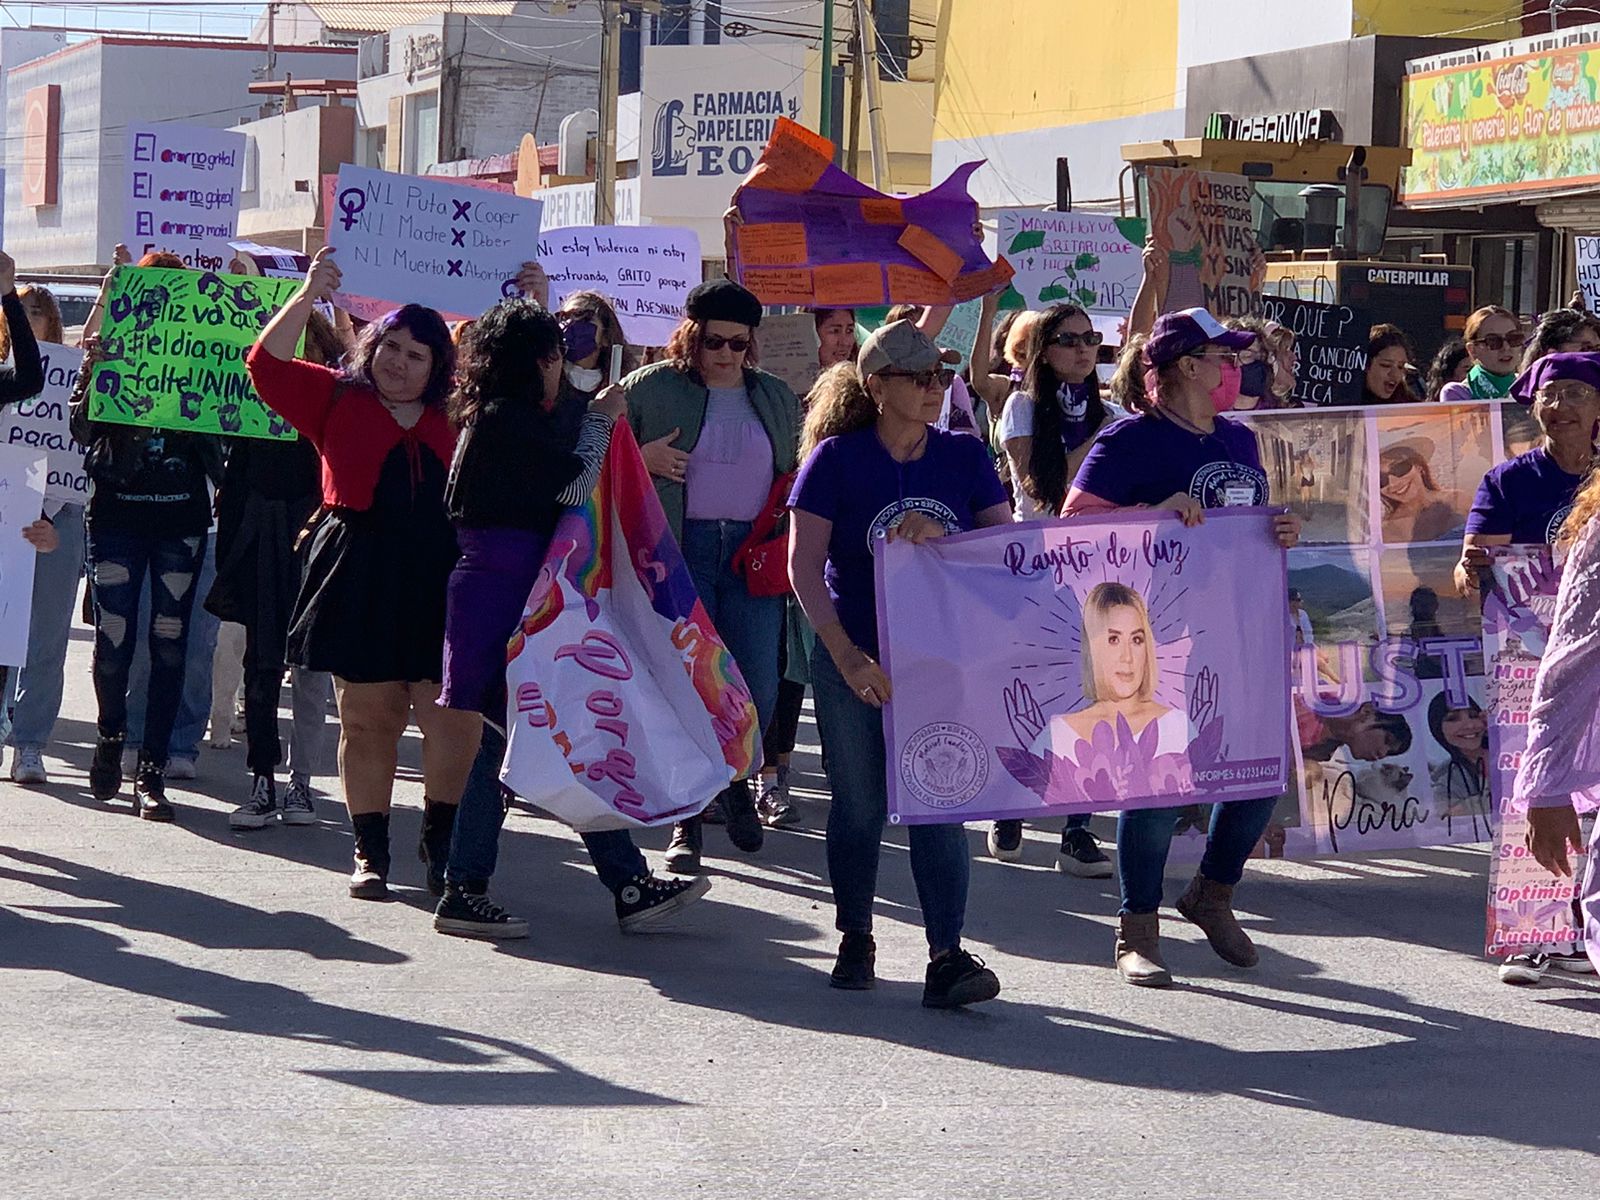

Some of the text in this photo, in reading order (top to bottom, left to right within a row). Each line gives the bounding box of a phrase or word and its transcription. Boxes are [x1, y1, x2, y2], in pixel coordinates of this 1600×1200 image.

[694, 91, 801, 119] FARMACIA y
[1548, 104, 1561, 131] de
[697, 119, 776, 142] PAPELERI
[133, 133, 156, 161] El
[133, 172, 152, 199] El
[1197, 181, 1250, 202] LIBRES
[366, 180, 393, 205] NI
[407, 186, 446, 216] Puta
[474, 201, 520, 225] Coger
[136, 211, 154, 236] El
[358, 212, 384, 237] NI
[399, 215, 446, 244] Madre
[472, 229, 511, 249] Deber
[537, 236, 686, 263] Ni estoy histerica ni estoy
[1198, 222, 1256, 253] VIVAS
[354, 247, 381, 268] NI
[393, 248, 444, 276] Muerta
[464, 260, 513, 282] Abortar
[1224, 255, 1252, 277] SIN
[1367, 268, 1449, 286] CATERPILLAR
[617, 267, 651, 283] GRITO
[658, 277, 687, 292] porque
[636, 299, 685, 317] ASESINAN
[1293, 304, 1330, 338] QUÉ
[1309, 344, 1368, 371] CANCIÓN
[1309, 364, 1333, 382] QUE
[8, 425, 67, 451] para
[1003, 529, 1191, 585] Rayito de luz
[1323, 770, 1430, 854] Para
